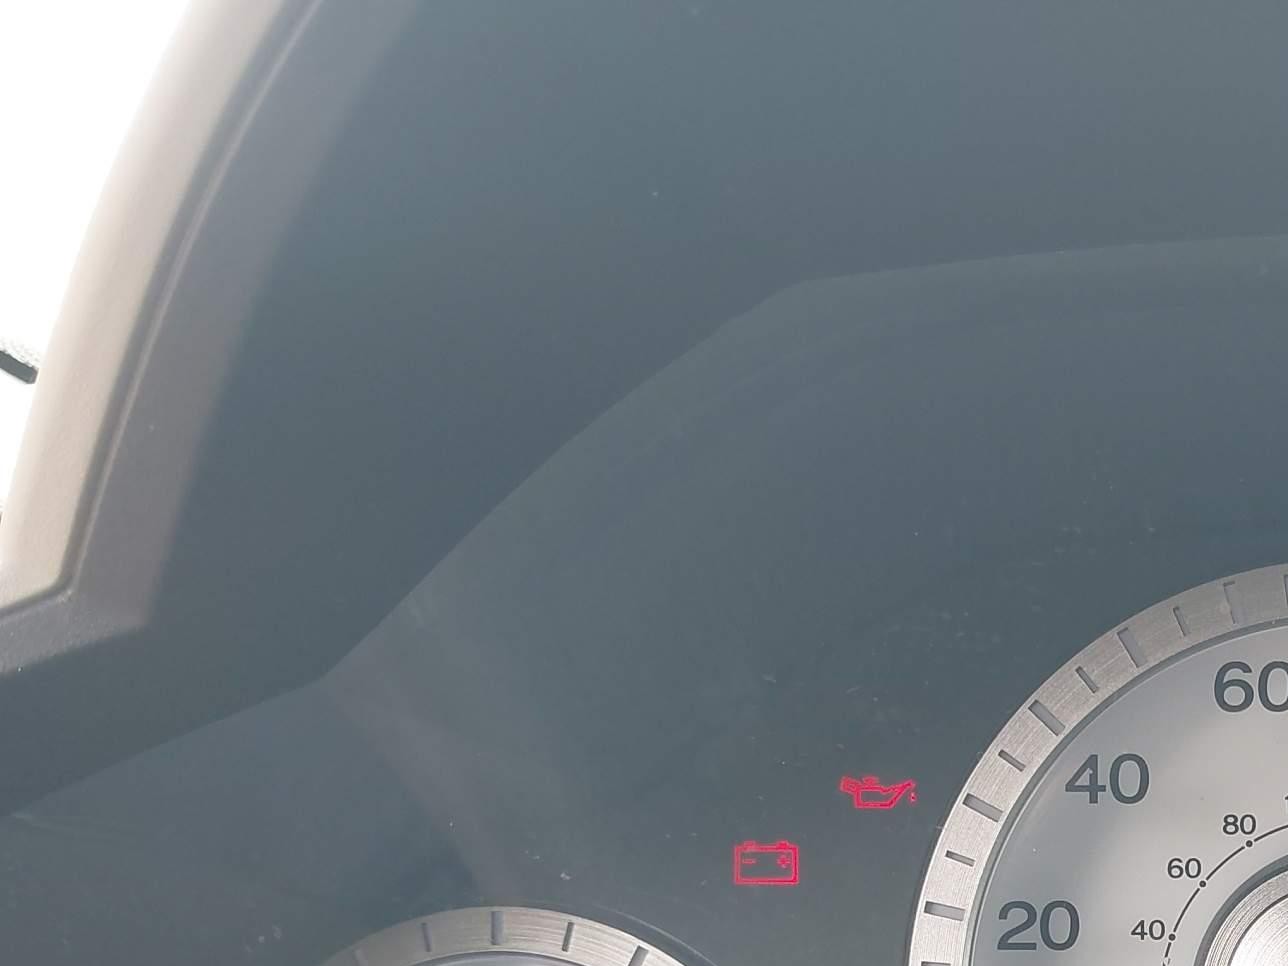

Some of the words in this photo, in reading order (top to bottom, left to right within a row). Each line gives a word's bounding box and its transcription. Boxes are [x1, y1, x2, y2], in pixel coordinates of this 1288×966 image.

[1064, 754, 1150, 805] 40
[1222, 813, 1258, 835] 80
[1167, 857, 1202, 879] 60
[997, 900, 1080, 952] 20
[1130, 919, 1166, 941] 40
